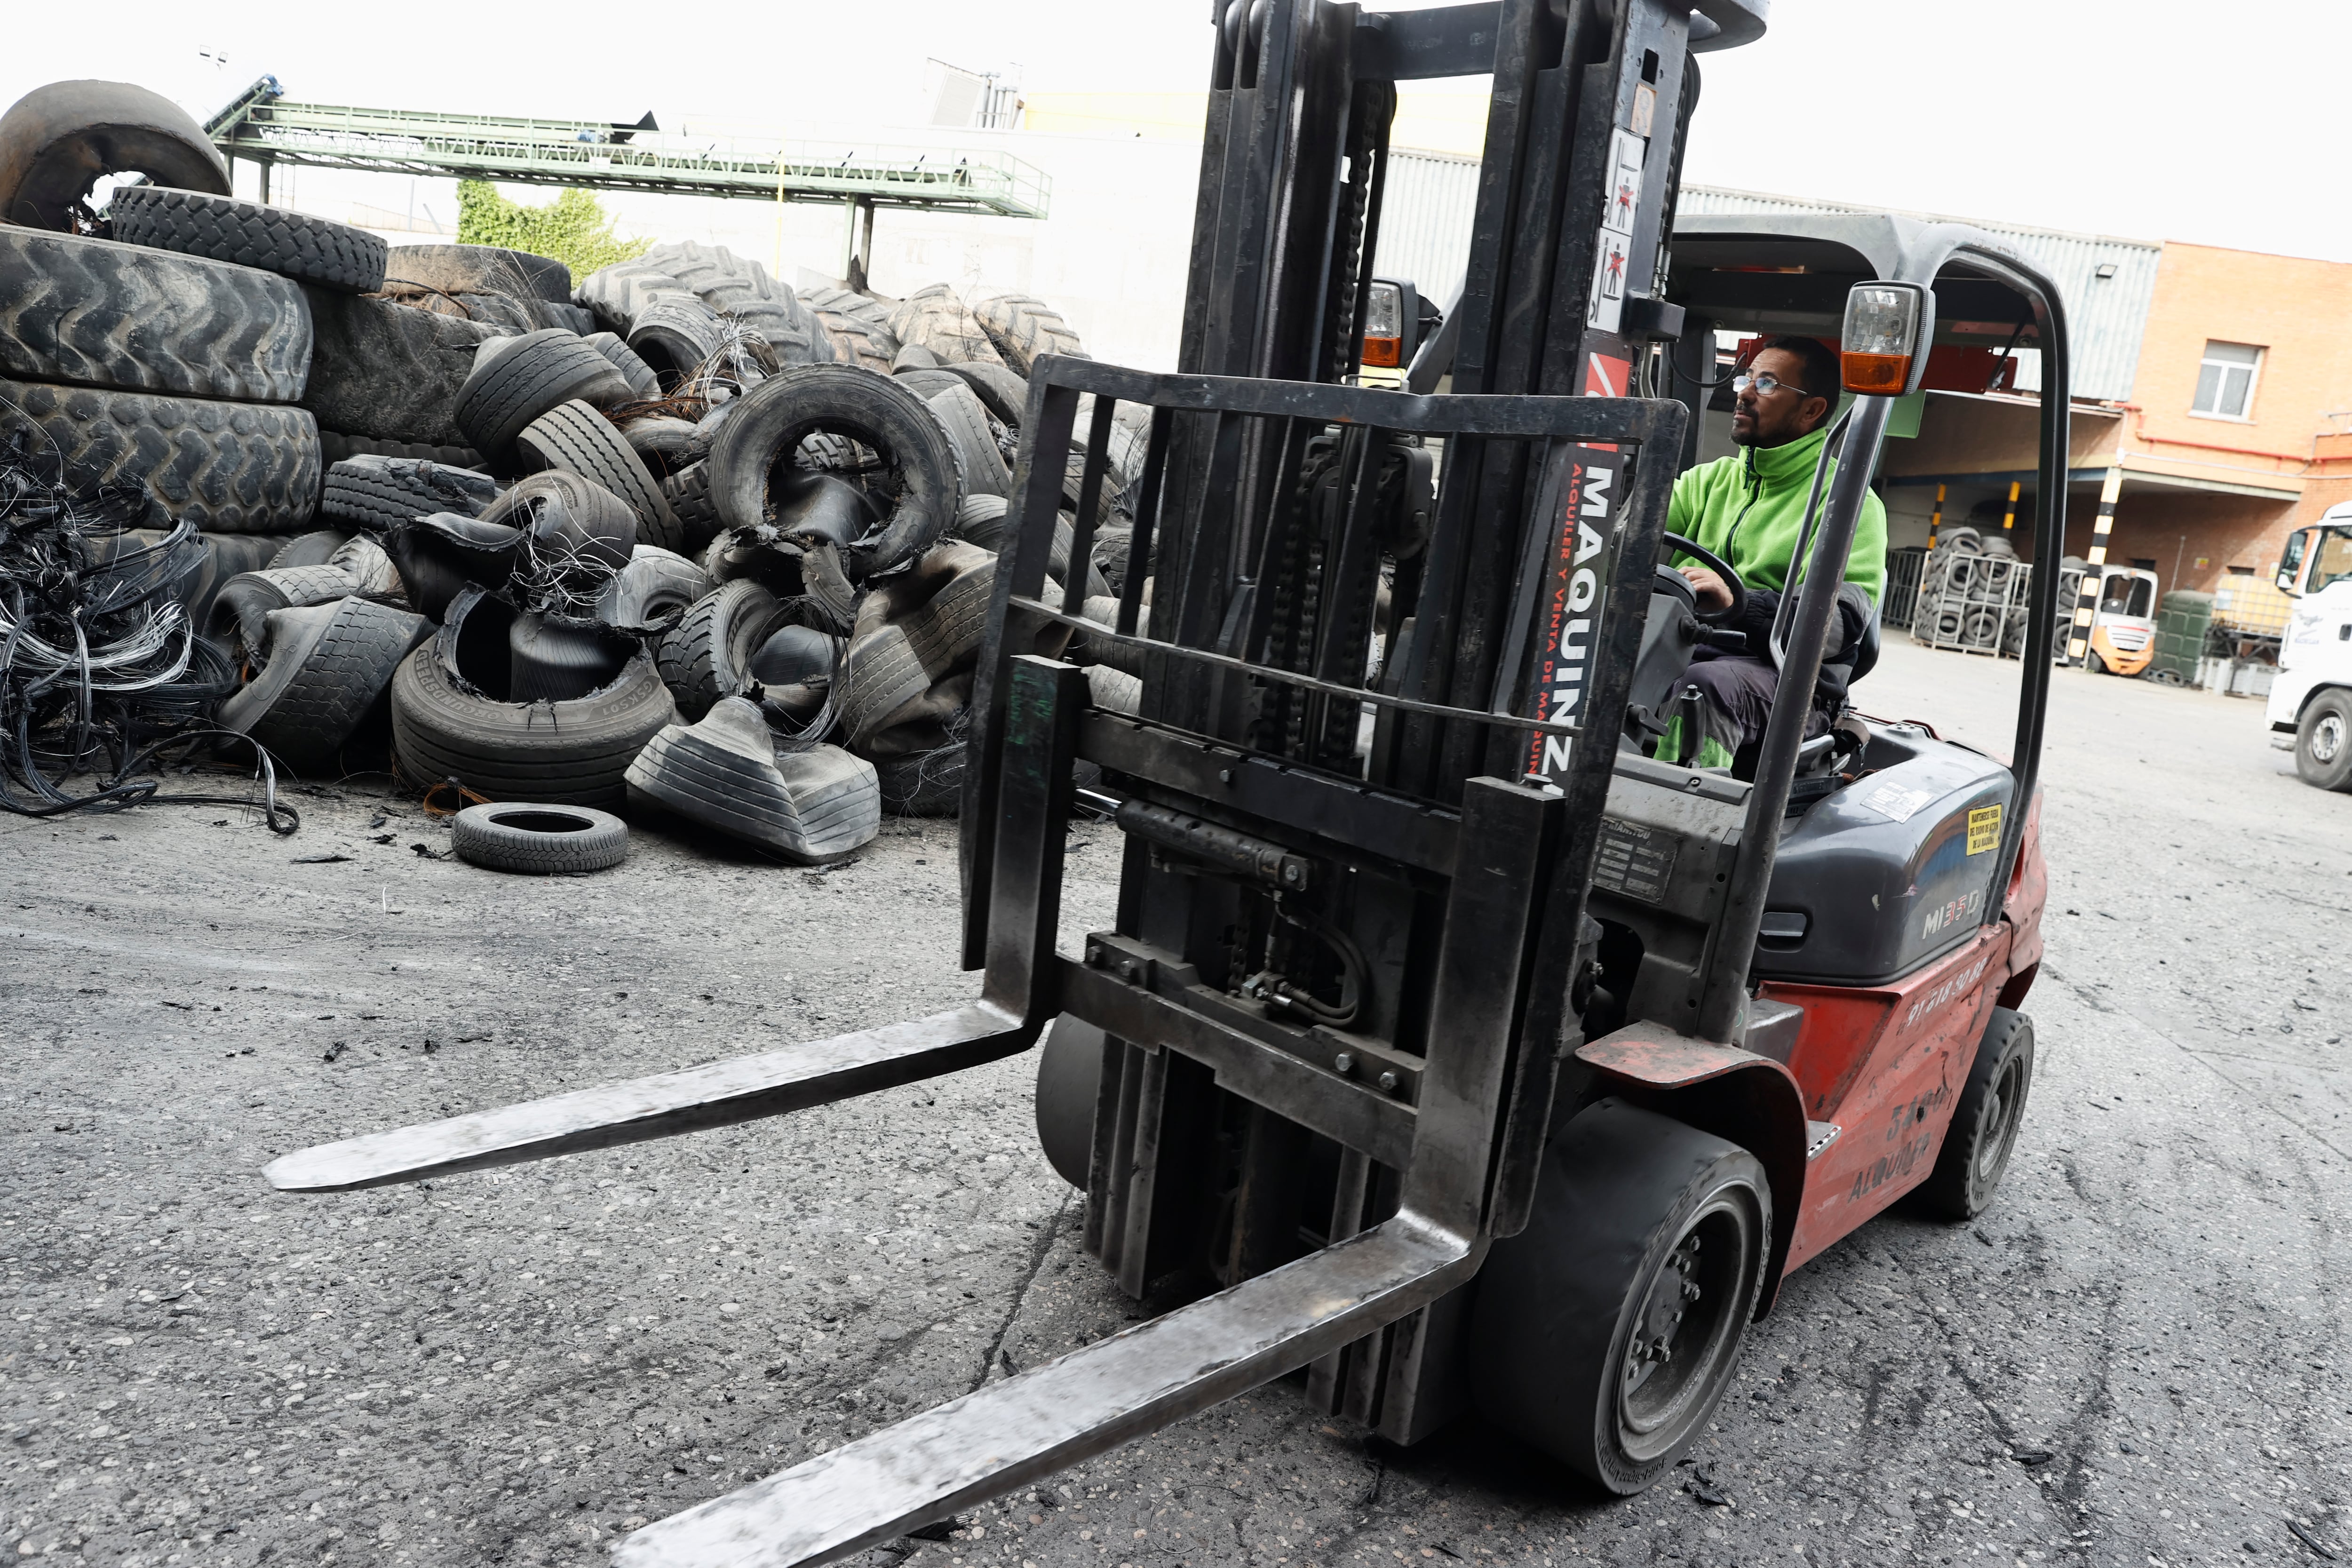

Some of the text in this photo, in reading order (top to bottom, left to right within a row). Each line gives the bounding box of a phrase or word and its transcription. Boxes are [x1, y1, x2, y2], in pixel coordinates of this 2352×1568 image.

[1560, 463, 1582, 559] ALQUILER
[1558, 567, 1568, 580] Y
[1541, 466, 1613, 796] MAQUINZ
[1547, 588, 1565, 653] VENTA
[415, 650, 501, 720] GROUNDSPEED
[1542, 661, 1553, 683] DE
[602, 680, 652, 716] GSKS01
[1971, 808, 1999, 823] MANTENERSE FUERA
[1976, 825, 1985, 836] RADIO
[1985, 824, 1989, 833] DE
[1973, 839, 1977, 849] DE
[1977, 838, 1981, 848] LA
[1906, 999, 1926, 1027] 91
[1925, 980, 1953, 1013] 818
